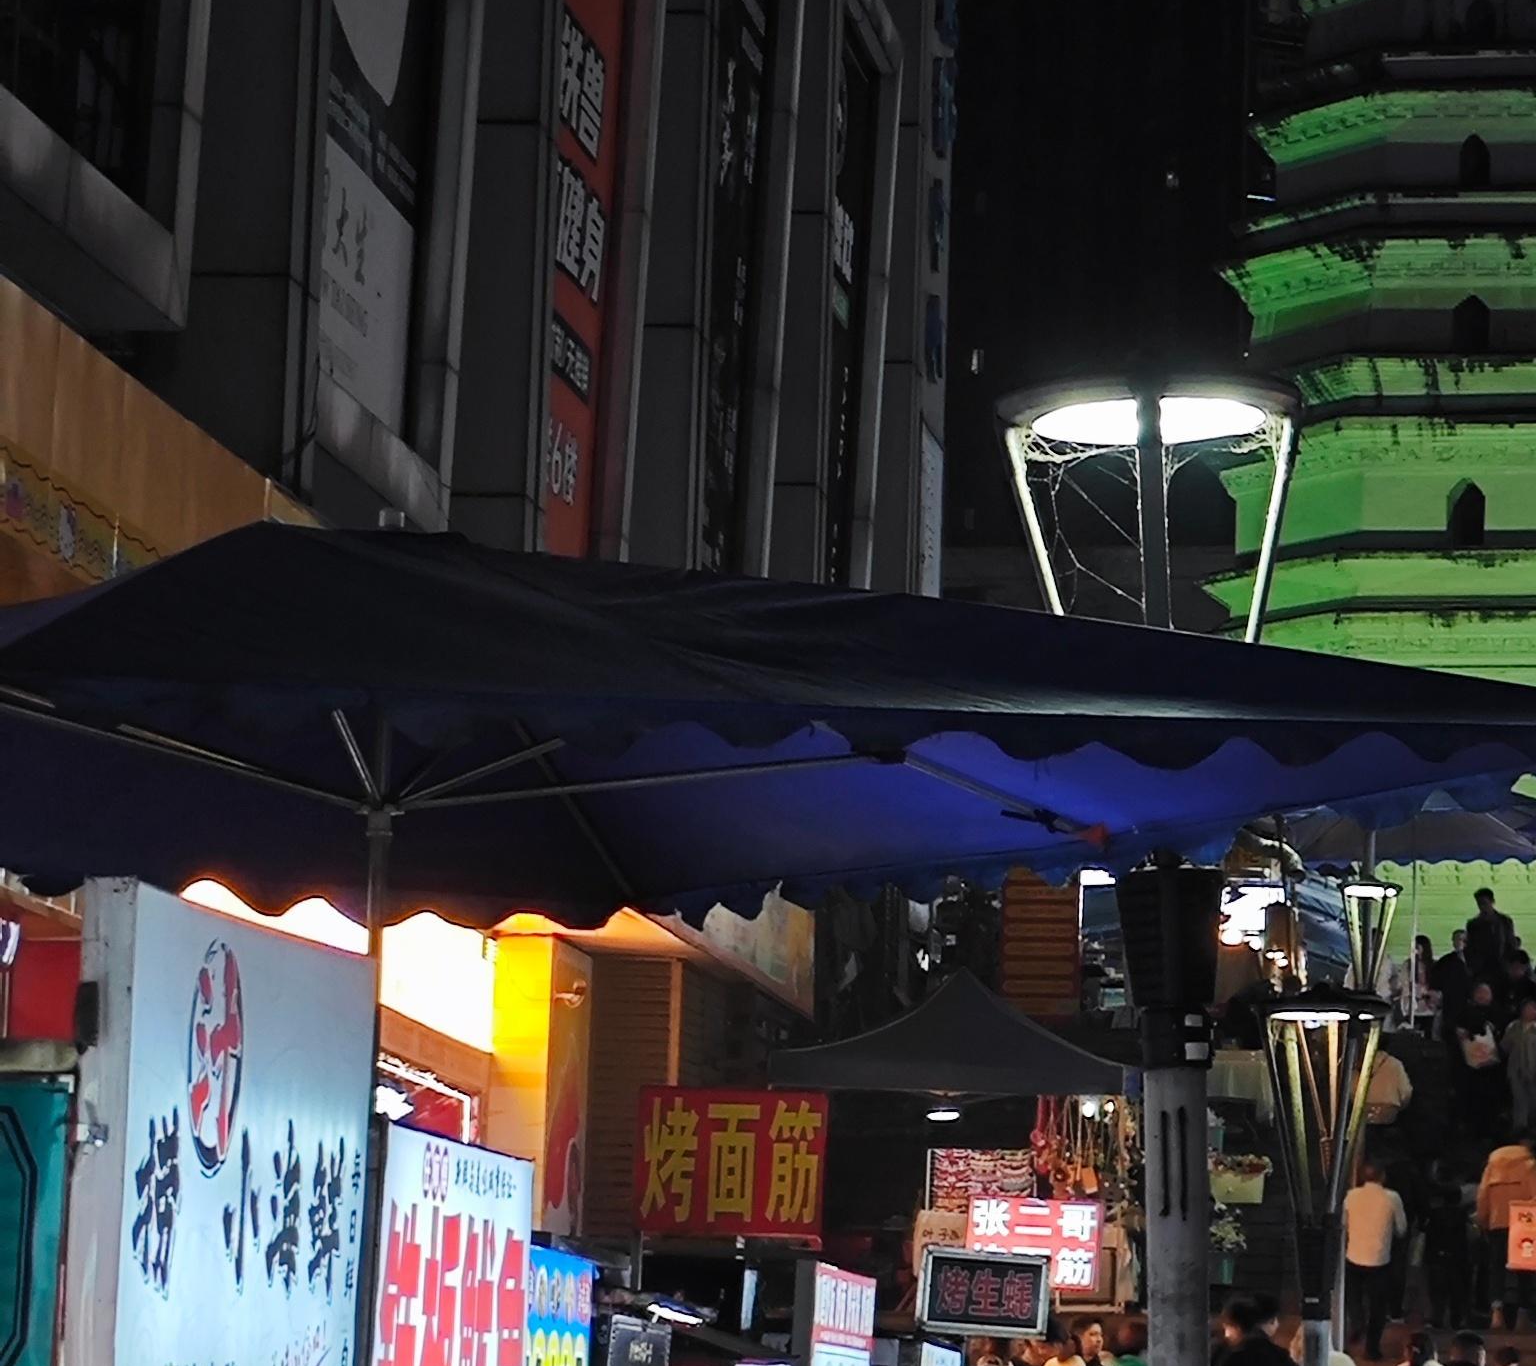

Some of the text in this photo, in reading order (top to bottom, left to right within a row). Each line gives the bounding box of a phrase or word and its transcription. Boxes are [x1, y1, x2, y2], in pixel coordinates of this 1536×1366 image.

[641, 1096, 822, 1225] 烤面筋
[937, 1266, 1033, 1319] 烤生蚝
